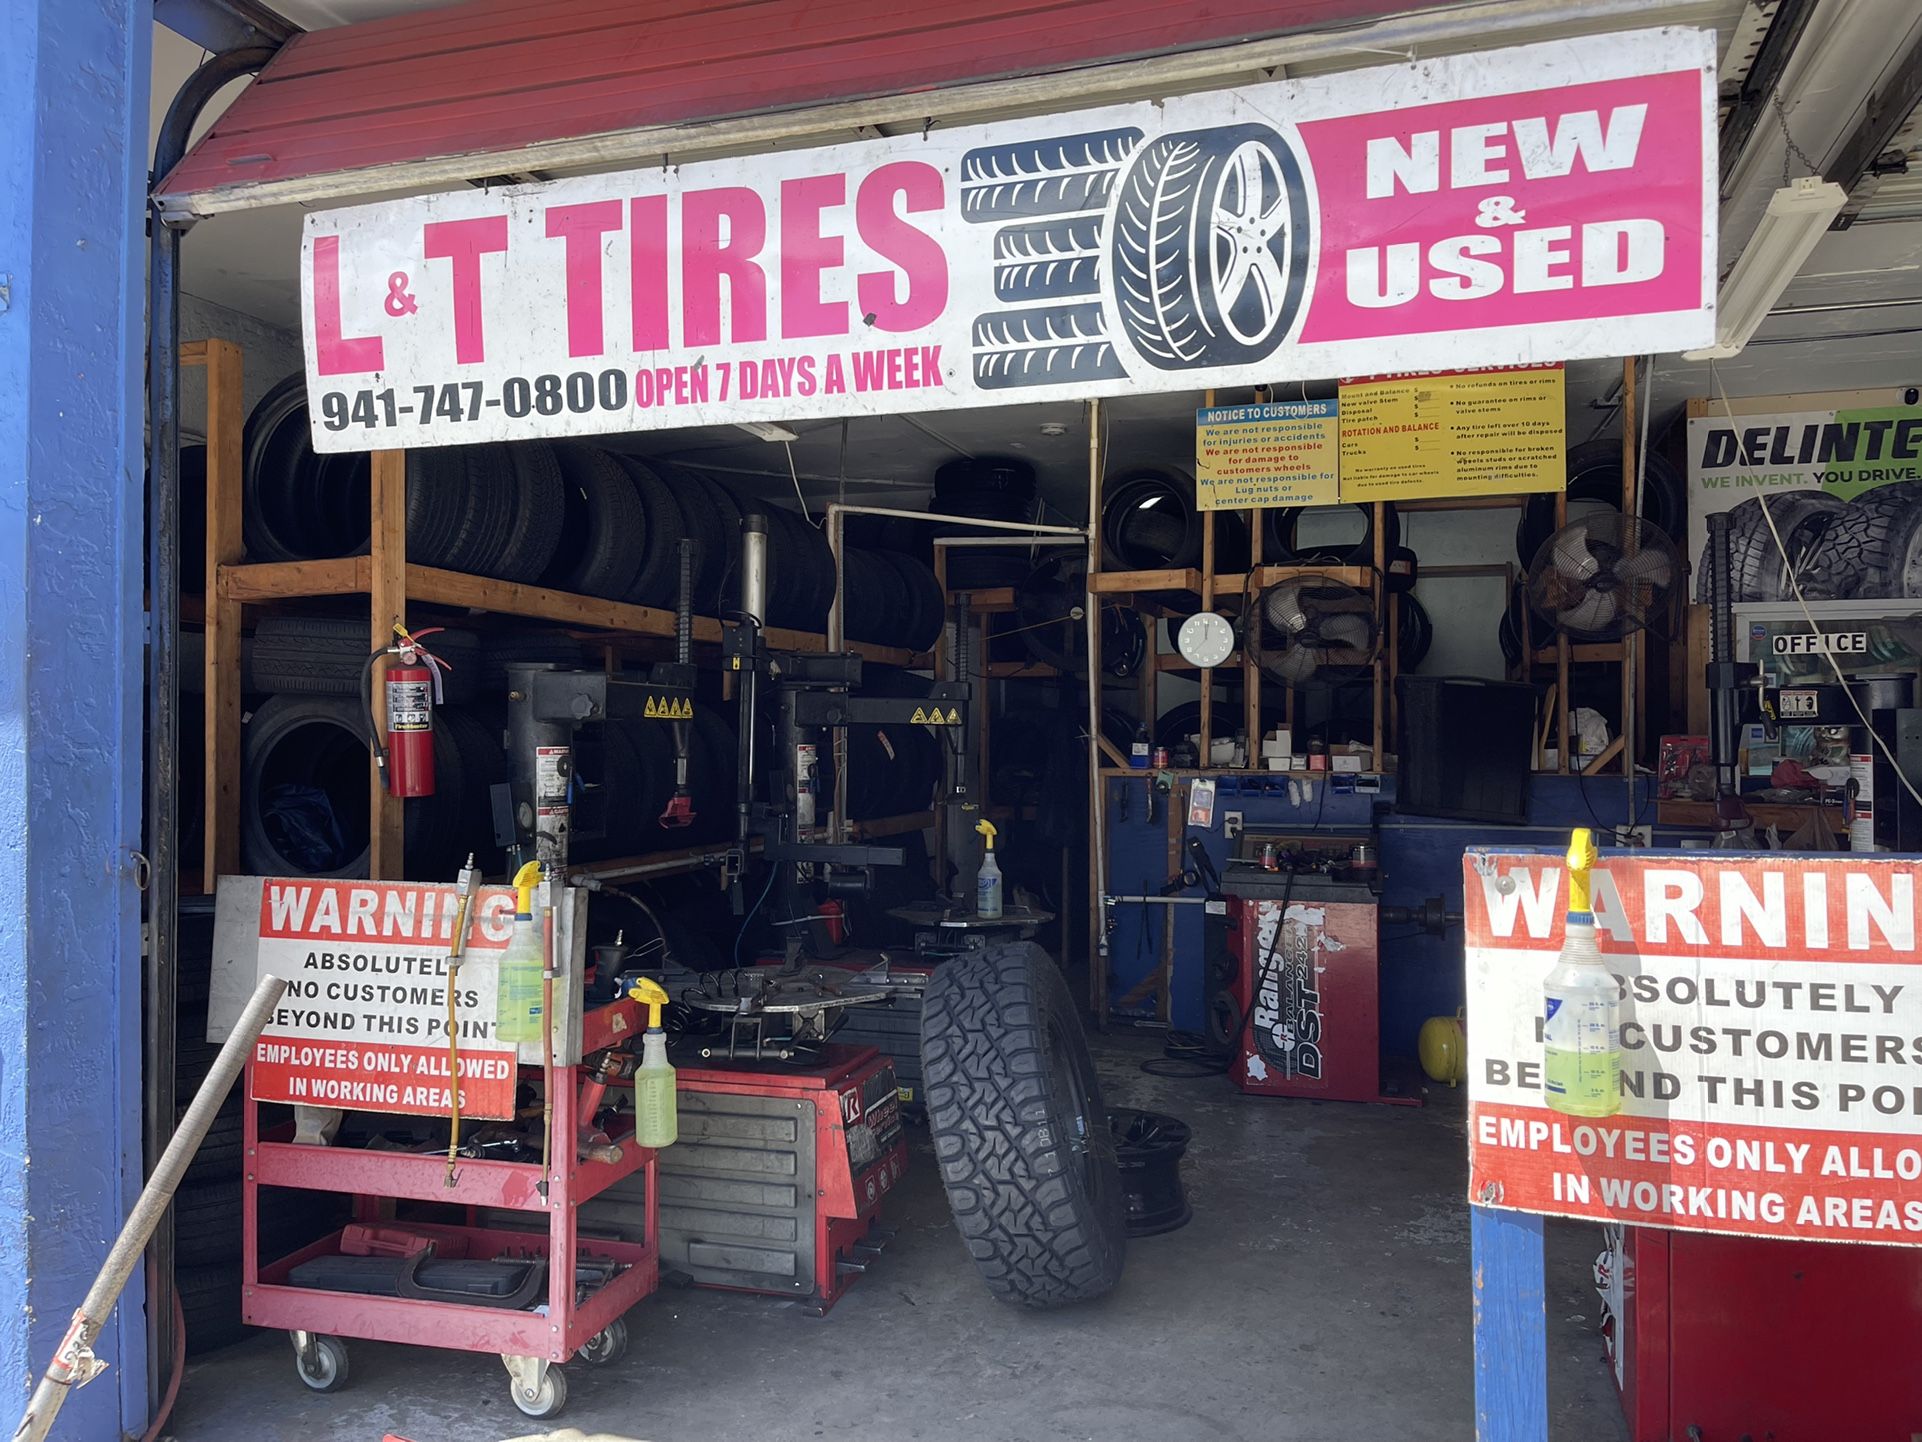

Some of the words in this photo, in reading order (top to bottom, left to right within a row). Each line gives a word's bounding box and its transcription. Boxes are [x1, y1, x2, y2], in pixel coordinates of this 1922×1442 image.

[1366, 103, 1648, 199] NEW
[1475, 196, 1526, 228] &
[314, 236, 385, 376] L
[384, 271, 418, 317] &
[424, 215, 508, 365] T
[545, 160, 949, 357] TIRES
[1346, 218, 1665, 308] USED
[636, 363, 709, 409] OPEN
[716, 361, 732, 402] 7
[739, 355, 817, 401] DAYS
[824, 353, 846, 394] A
[851, 344, 944, 392] WEEK
[322, 368, 629, 432] 941-747-0800
[1468, 398, 1507, 406] guarantee
[1208, 408, 1245, 422] NOTICE
[1247, 408, 1261, 419] TO
[1263, 403, 1327, 418] CUSTOMERS
[1357, 415, 1378, 423] patch
[1219, 436, 1258, 446] injuries
[1273, 432, 1326, 442] accidents
[1242, 426, 1259, 434] not
[1261, 422, 1323, 433] responsible
[1342, 425, 1381, 437] ROTATION
[1383, 425, 1400, 434] AND
[1401, 422, 1440, 433] BALANCE
[1205, 448, 1220, 456] We
[1223, 447, 1240, 455] are
[1242, 446, 1259, 454] not
[1261, 442, 1323, 453] responsible
[1228, 457, 1242, 465] for
[1245, 455, 1286, 464] damage
[1468, 448, 1513, 457] responsible
[1200, 478, 1218, 486] We
[1236, 476, 1253, 484] not
[1256, 472, 1317, 483] responsible
[1216, 465, 1271, 475] customers
[1274, 463, 1312, 472] wheels
[1701, 476, 1730, 489] WE
[1735, 473, 1809, 488] INVENT.
[1812, 470, 1854, 484] YOU
[1858, 467, 1921, 482] DRIVE.
[1215, 496, 1248, 505] center
[1250, 495, 1270, 503] cap
[1272, 494, 1314, 503] damage
[1235, 486, 1254, 494] Lug
[288, 980, 319, 999] NO
[326, 982, 479, 1008] CUSTOMERS
[266, 1008, 355, 1030] EYOND
[362, 1014, 419, 1035] THIS
[427, 1018, 496, 1039] POIN
[256, 1043, 358, 1070] EMPLOYEES
[363, 1051, 413, 1074] ONLY
[289, 1077, 307, 1095] IN
[311, 1079, 398, 1103] WORKING
[1485, 1058, 1681, 1100] BEND
[1698, 1074, 1820, 1111] THIS
[1478, 1115, 1695, 1165] EMPLOYEES
[1706, 1136, 1811, 1174] ONLY
[1553, 1172, 1589, 1203] IN
[1600, 1177, 1785, 1223] WORKING
[1796, 1196, 1922, 1231] AREAS
